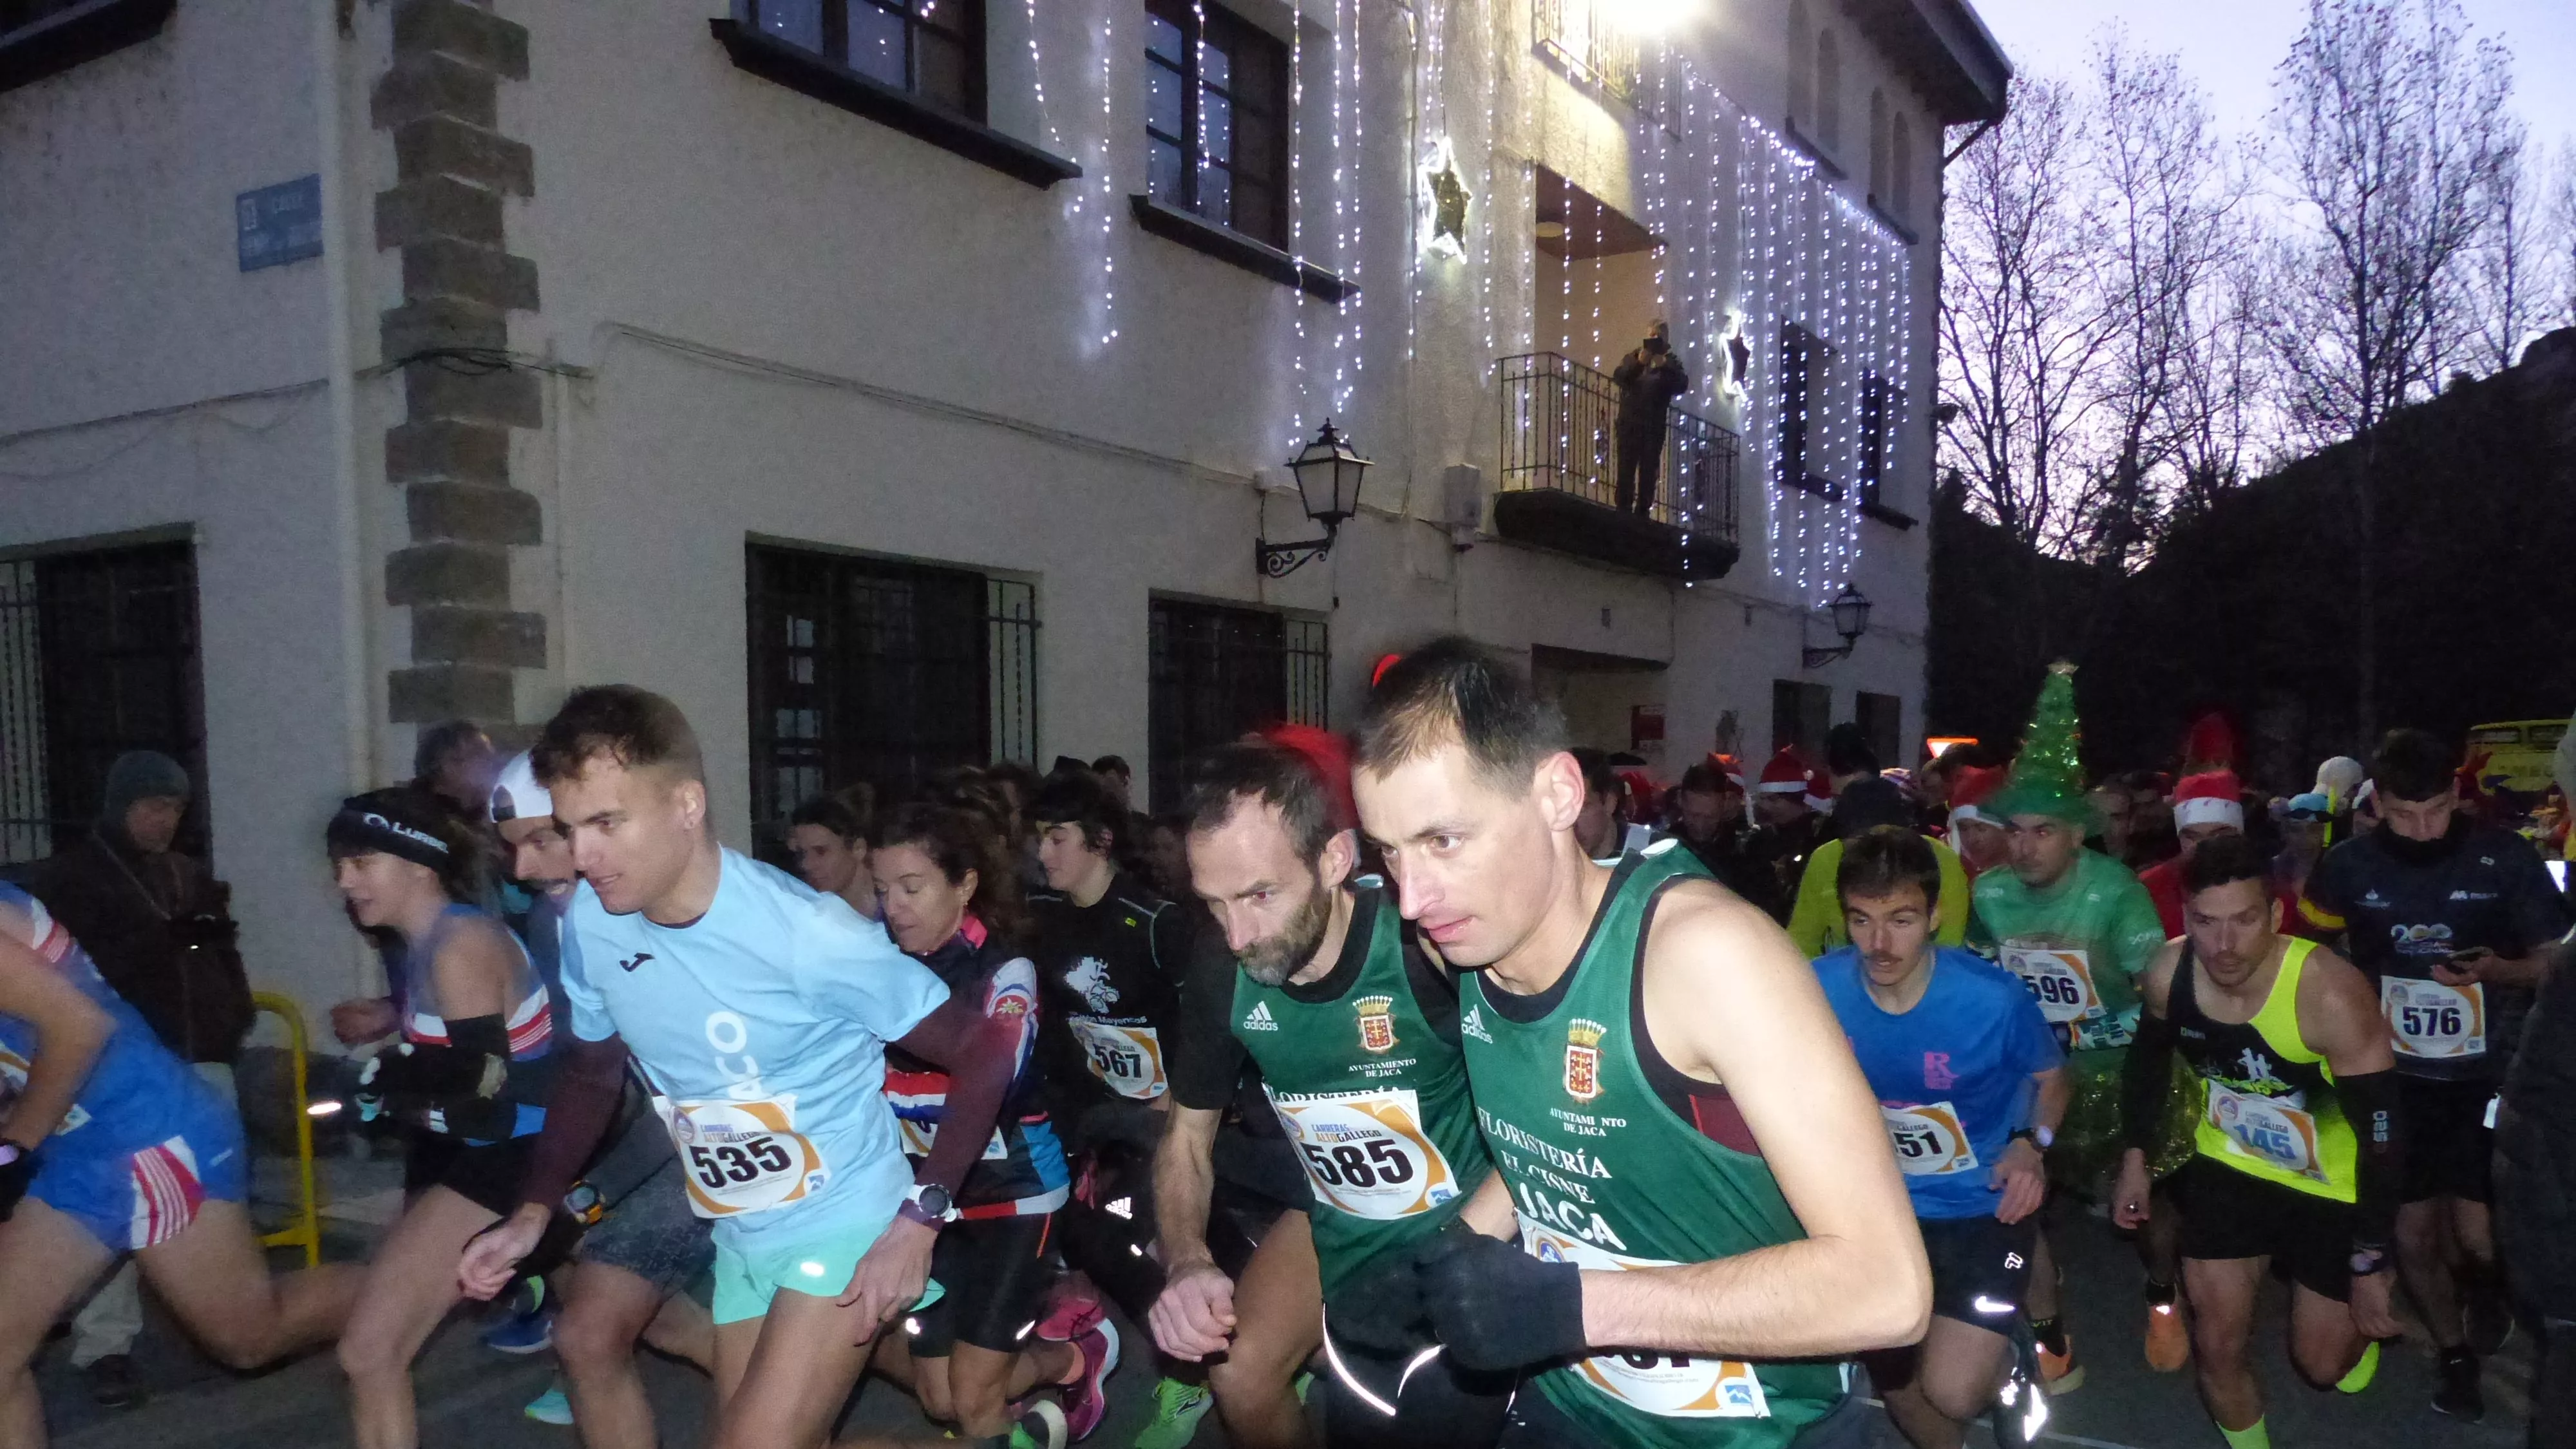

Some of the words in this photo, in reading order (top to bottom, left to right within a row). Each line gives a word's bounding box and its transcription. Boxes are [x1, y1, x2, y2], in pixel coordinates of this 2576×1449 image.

[1243, 1019, 1278, 1031] adidas
[1461, 1023, 1493, 1044] adidas
[2403, 1006, 2461, 1036] 576
[1093, 1043, 1142, 1078] 567
[1349, 1058, 1417, 1072] AYUNTAMIENTO
[1365, 1070, 1378, 1078] DE
[1379, 1068, 1402, 1078] JACA
[1549, 1107, 1627, 1128] AYUNTAMINTO
[1563, 1122, 1577, 1134] DE
[1578, 1126, 1607, 1137] JACA
[1477, 1106, 1613, 1179] FLORISTERÍA
[1893, 1130, 1944, 1158] 51
[688, 1137, 792, 1189] 535
[1300, 1139, 1414, 1188] 585
[1528, 1164, 1596, 1204] CISNE
[1519, 1182, 1627, 1251] JACA
